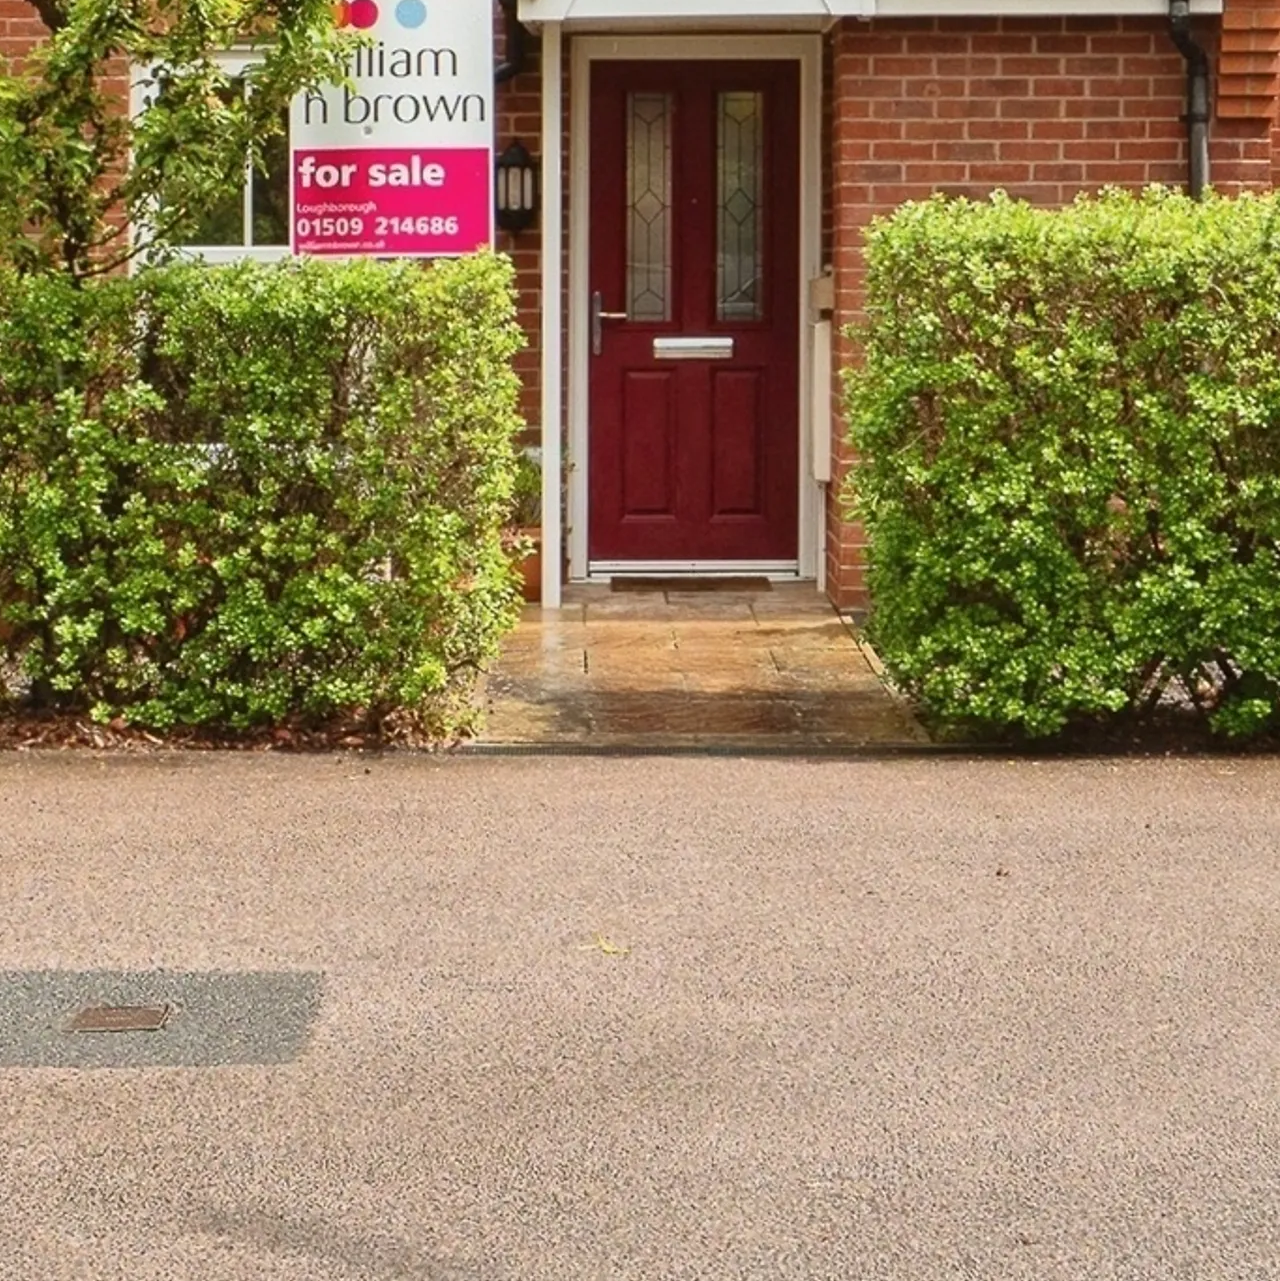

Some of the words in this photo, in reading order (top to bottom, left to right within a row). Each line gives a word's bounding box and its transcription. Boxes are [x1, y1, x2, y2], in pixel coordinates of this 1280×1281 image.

[328, 38, 458, 78] lliam
[343, 83, 485, 125] brown
[298, 157, 357, 188] for
[368, 155, 445, 187] sale
[296, 201, 377, 215] Loughborough
[297, 217, 363, 236] 01509
[374, 215, 459, 235] 214686
